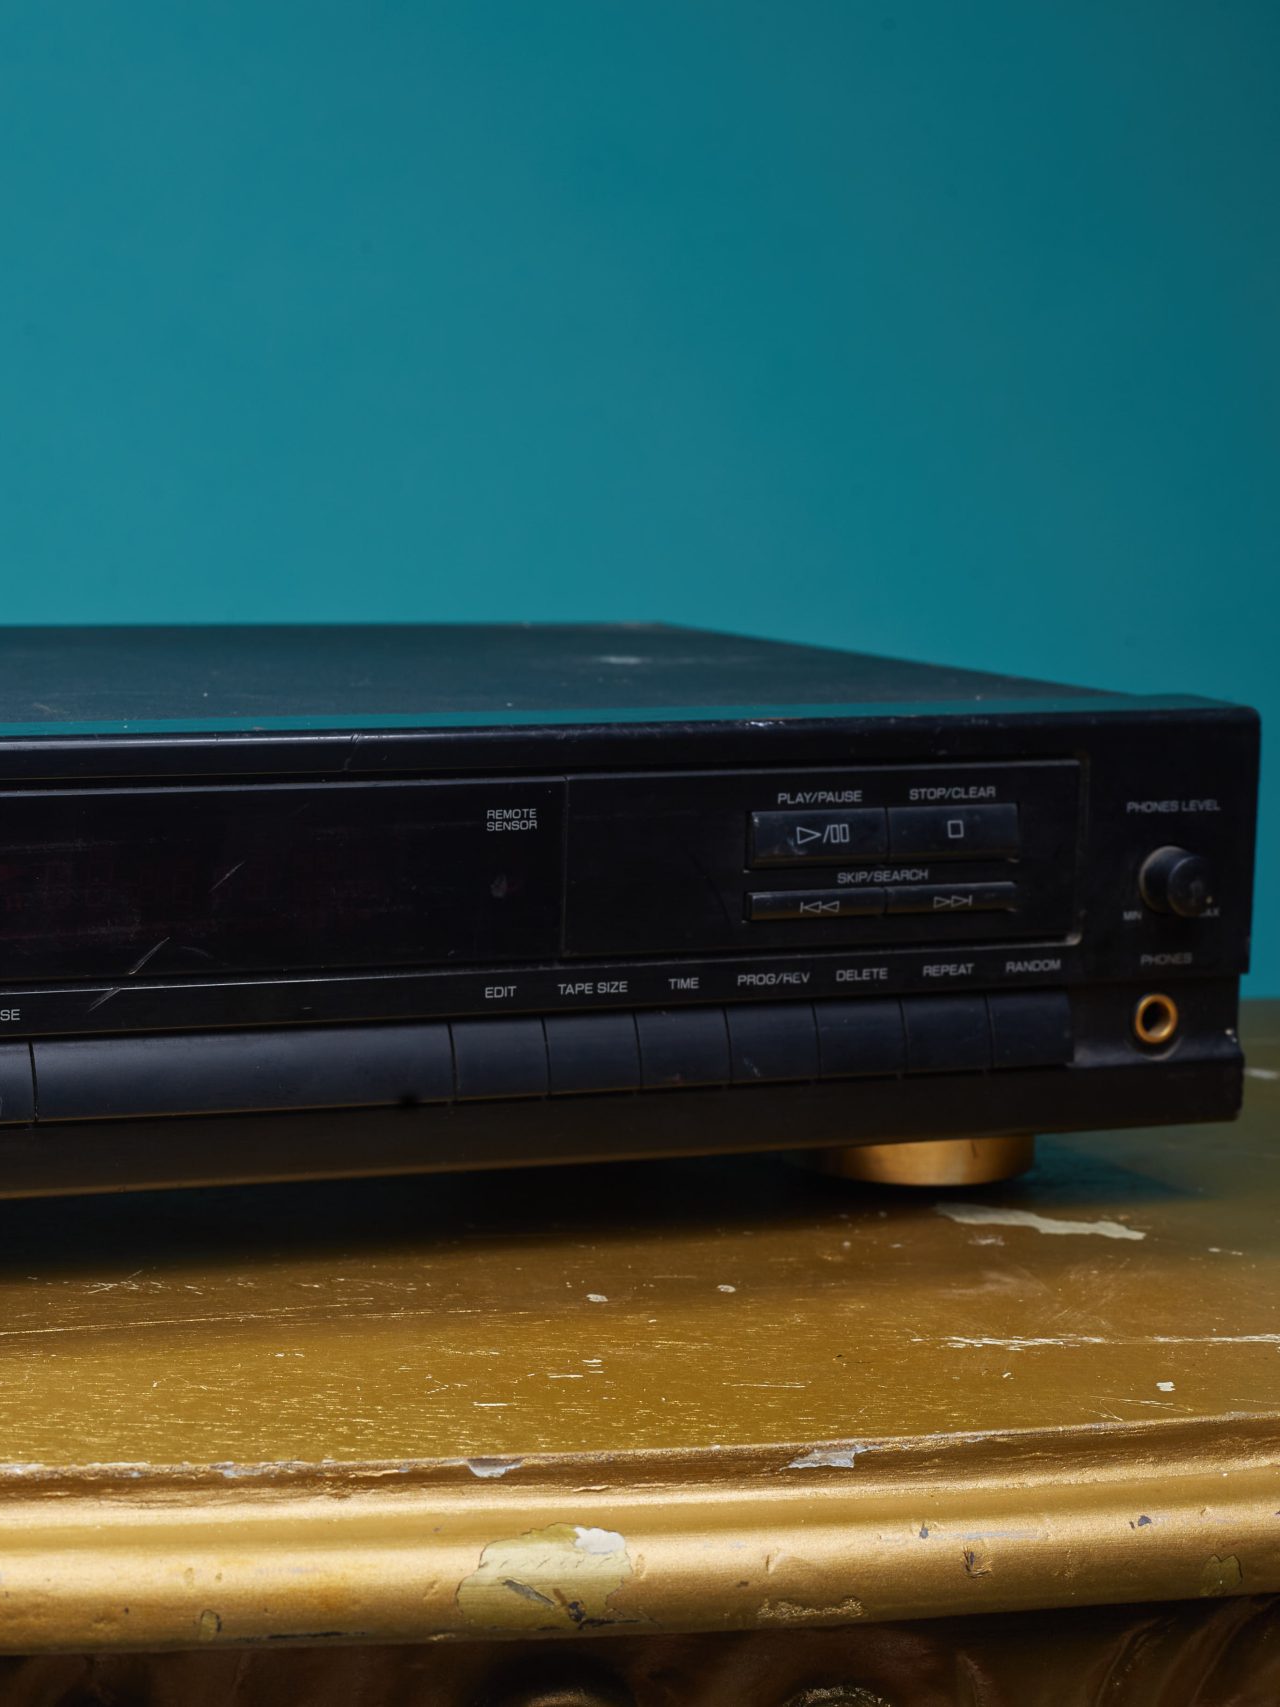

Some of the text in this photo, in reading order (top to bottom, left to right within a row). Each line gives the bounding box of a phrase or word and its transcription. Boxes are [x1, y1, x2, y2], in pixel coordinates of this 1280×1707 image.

[777, 790, 862, 805] PLAY/PAUSE
[909, 786, 996, 801] STOP/CLEAR
[1126, 799, 1220, 813] PHONES LEVEL
[486, 808, 537, 820] REMOTE
[486, 819, 538, 831] SENSOR
[837, 869, 929, 884] SKIP/SEARCH
[1199, 907, 1220, 918] AX
[922, 962, 976, 979] REPEAT
[1005, 958, 1062, 975] RANDOM
[835, 967, 889, 983] DELETE
[484, 984, 517, 998] EDIT
[557, 980, 629, 996] TAPE SIZE
[668, 976, 700, 991] TIME
